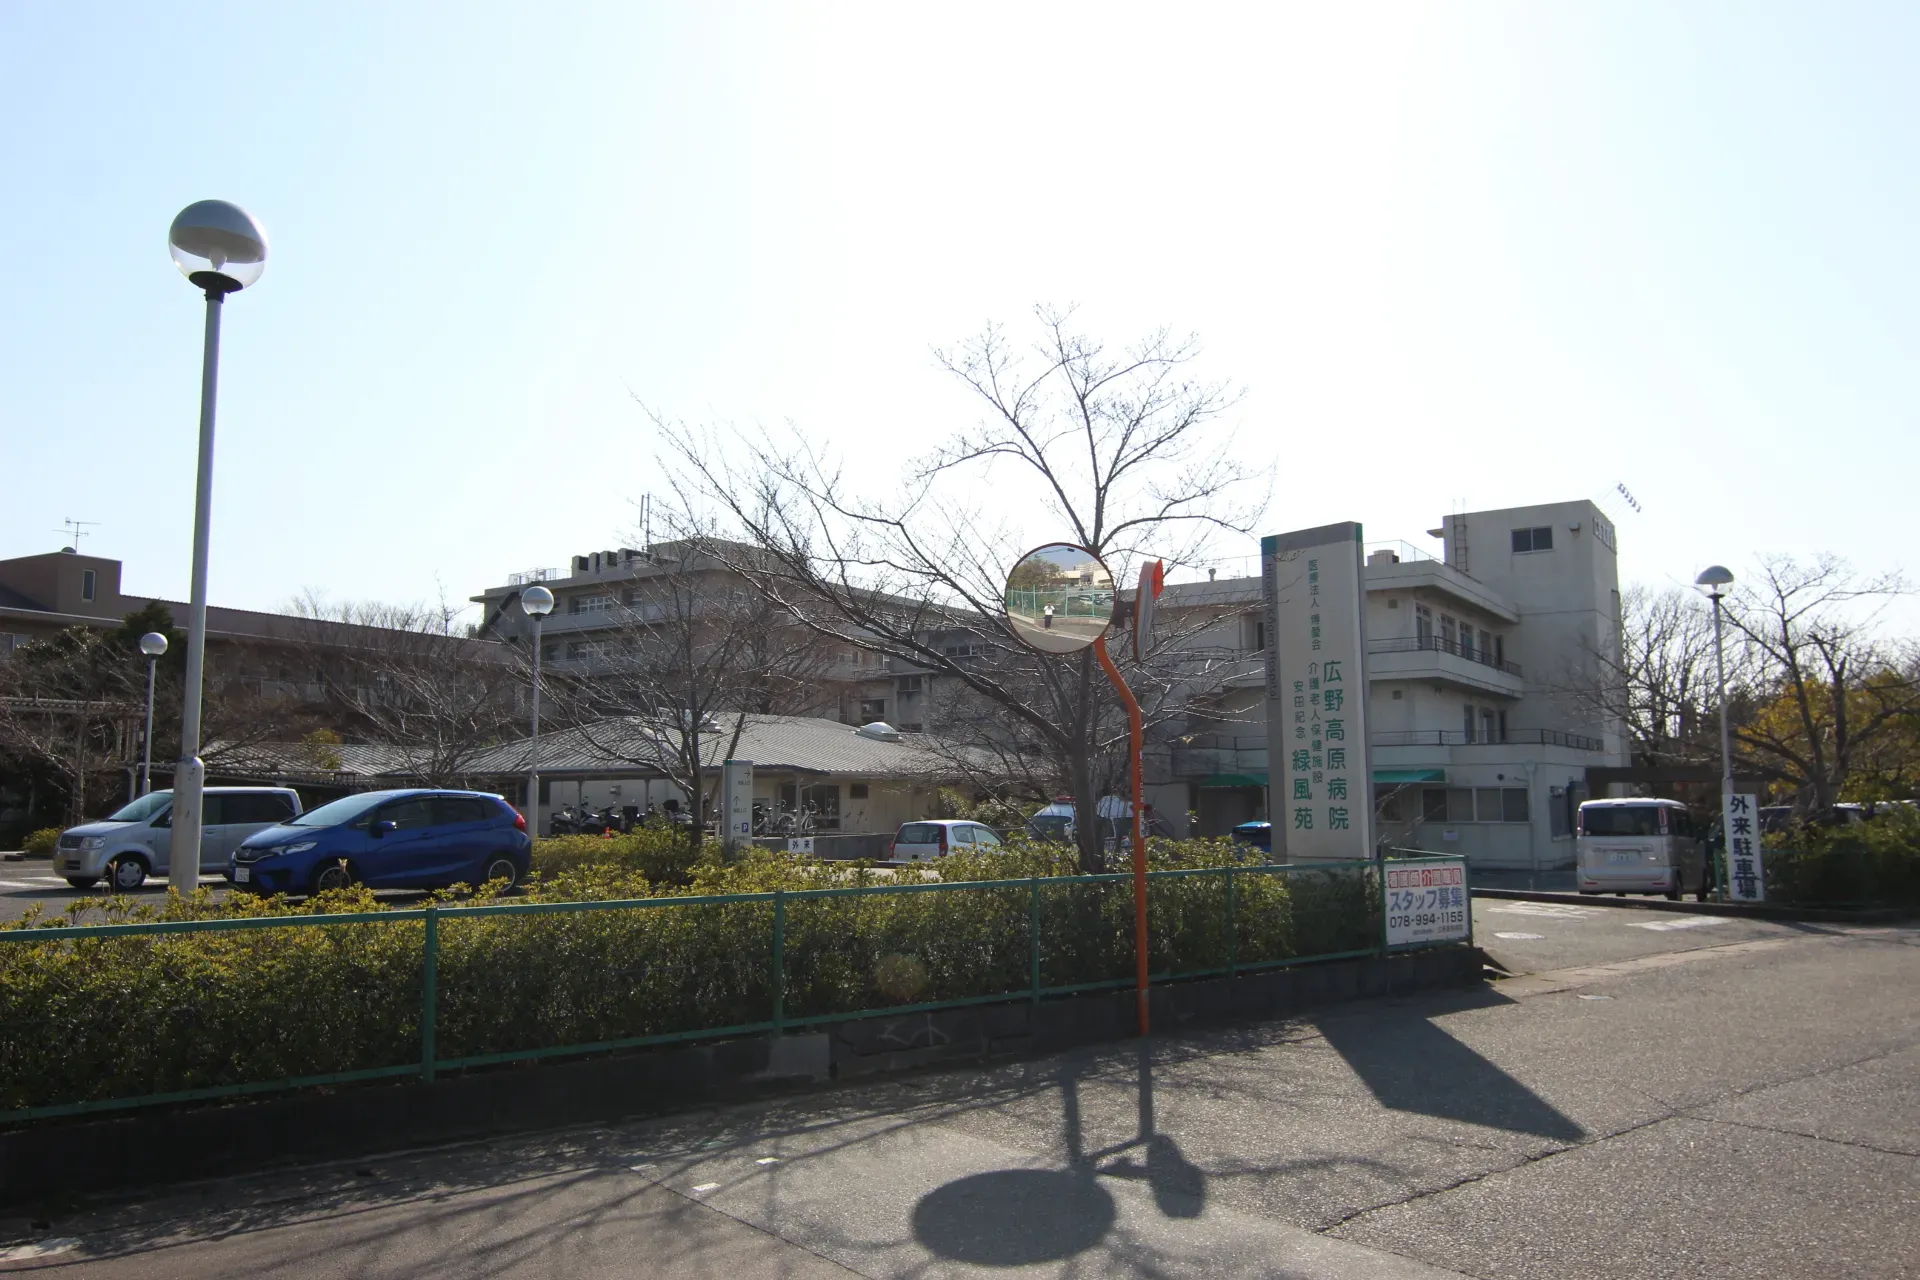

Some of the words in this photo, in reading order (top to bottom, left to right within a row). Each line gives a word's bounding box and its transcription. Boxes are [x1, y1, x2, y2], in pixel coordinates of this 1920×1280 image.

[1308, 559, 1320, 608] 医療法人
[1267, 651, 1278, 700] Hospital
[1293, 680, 1306, 739] 安田記念
[1308, 661, 1324, 784] 介護老人保健施設
[1323, 661, 1349, 830] 広野高原病院
[1292, 749, 1314, 830] 緑風苑
[1730, 795, 1761, 899] 外来駐車場
[1389, 887, 1463, 912] スタッフ募集
[1390, 911, 1464, 928] 078-994-1155
